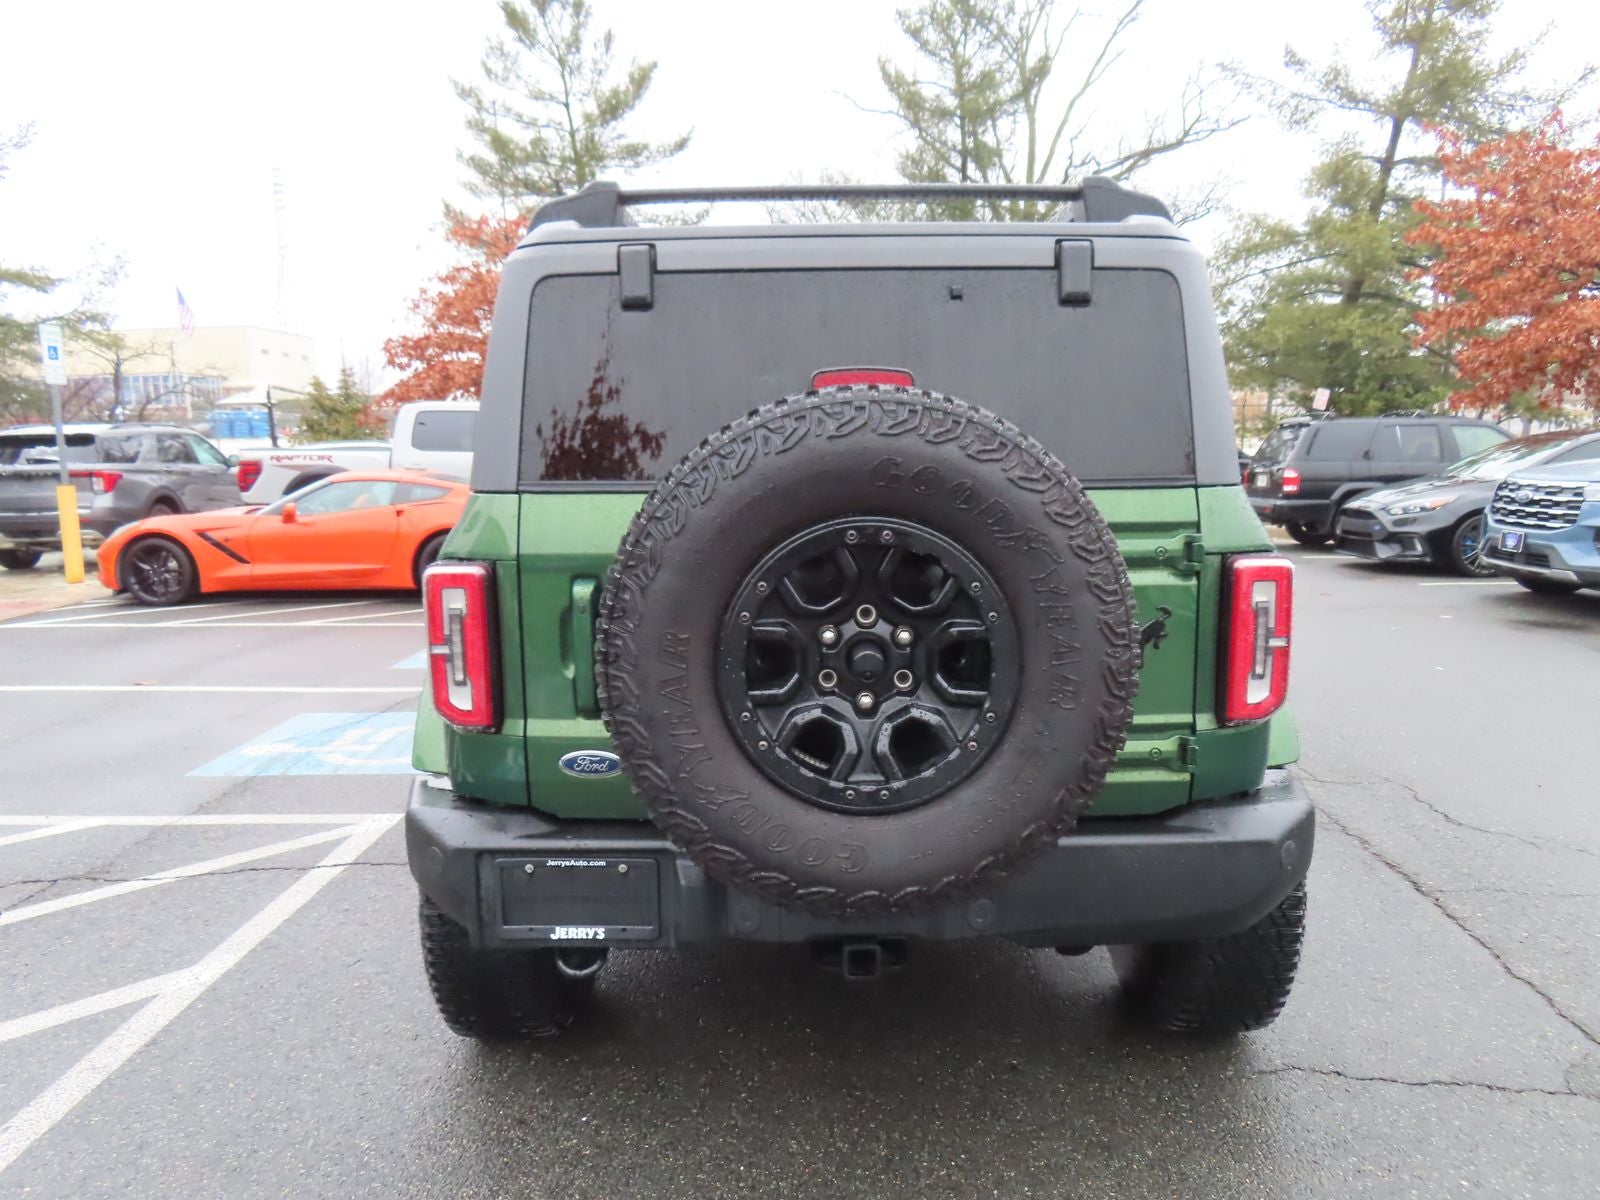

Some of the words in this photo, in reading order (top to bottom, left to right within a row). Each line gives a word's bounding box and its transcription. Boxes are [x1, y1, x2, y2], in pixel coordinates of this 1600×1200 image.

[270, 454, 334, 464] RAPTOR
[573, 755, 610, 772] Ford
[546, 859, 606, 867] JerrysAuto.com
[550, 926, 606, 940] JERRY'S
